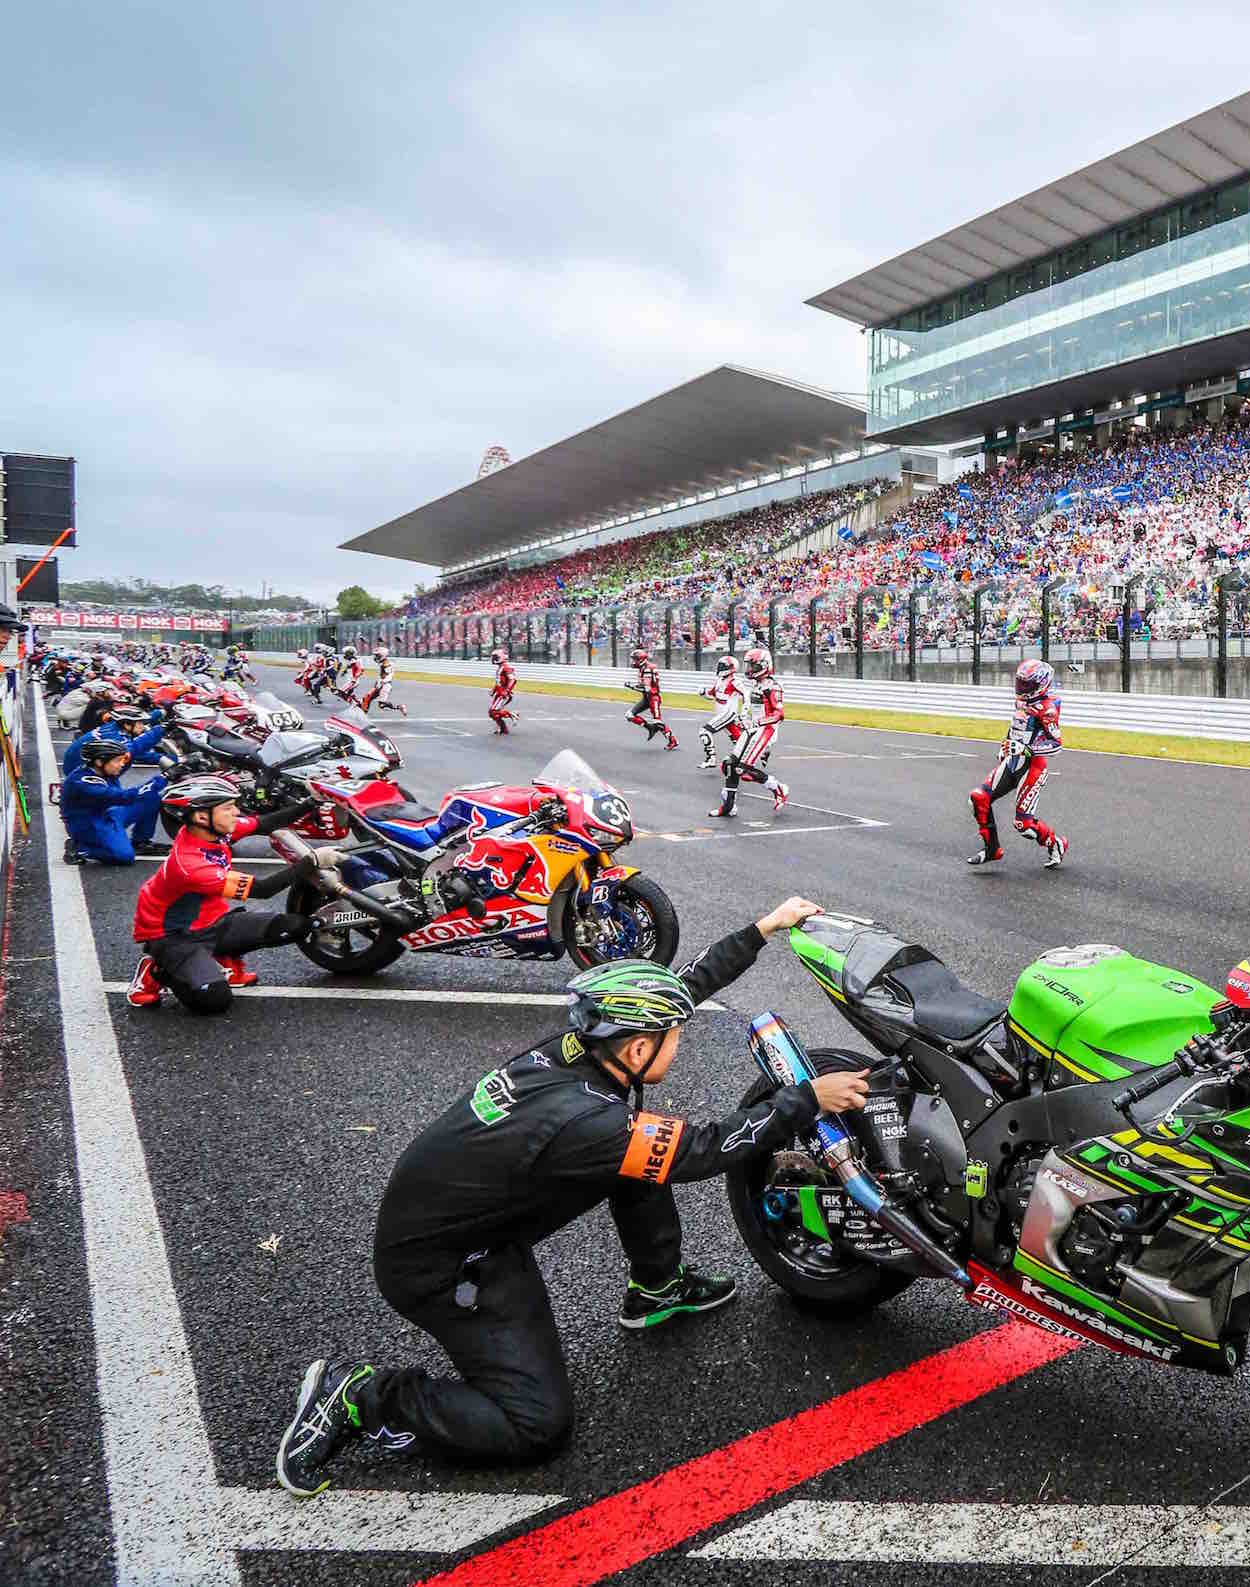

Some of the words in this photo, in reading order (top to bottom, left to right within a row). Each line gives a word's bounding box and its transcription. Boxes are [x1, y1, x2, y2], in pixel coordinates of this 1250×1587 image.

[84, 614, 117, 625] NGK
[140, 616, 172, 627] NGK
[194, 618, 226, 628] NGK
[601, 799, 630, 826] 33
[874, 1112, 898, 1125] BEET
[881, 1124, 908, 1137] NGK
[822, 1194, 841, 1206] RK
[1021, 1275, 1182, 1361] Kawasaki
